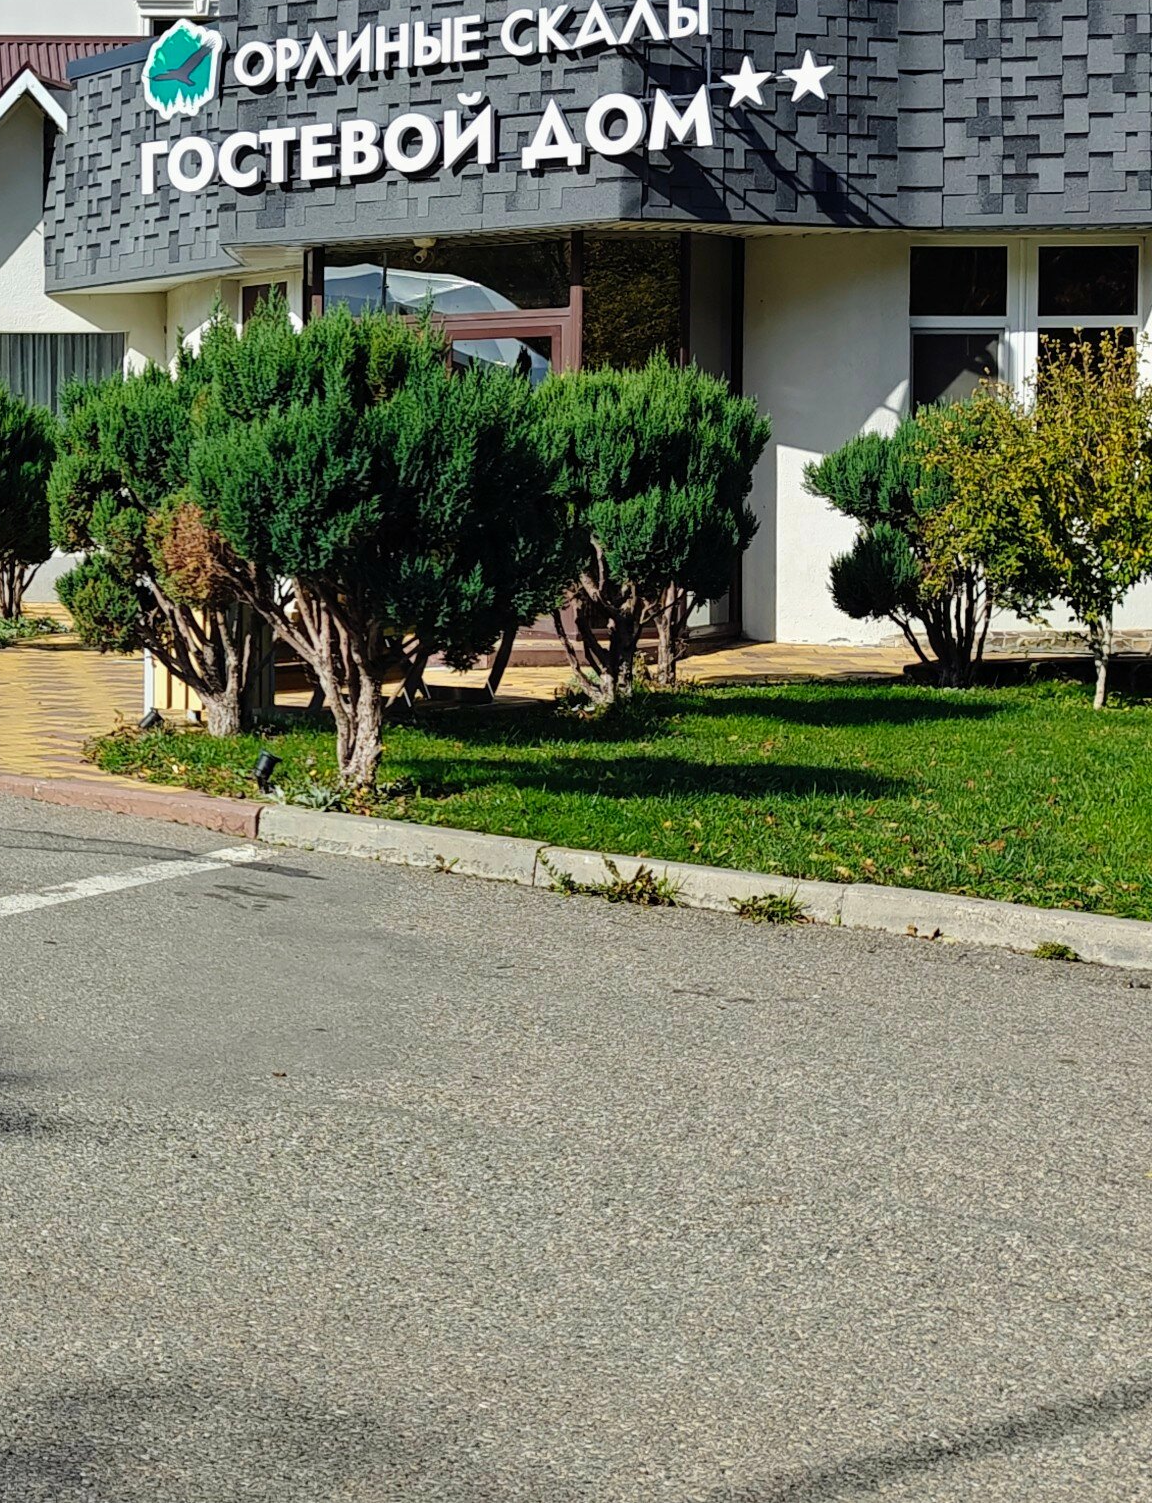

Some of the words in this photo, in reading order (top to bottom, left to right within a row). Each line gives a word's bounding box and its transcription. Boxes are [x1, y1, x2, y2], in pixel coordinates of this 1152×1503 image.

[233, 14, 482, 87] ОРЛИНЫЕ
[140, 91, 496, 194] ГОСТЕВОЙ
[521, 86, 714, 169] ДОМ
